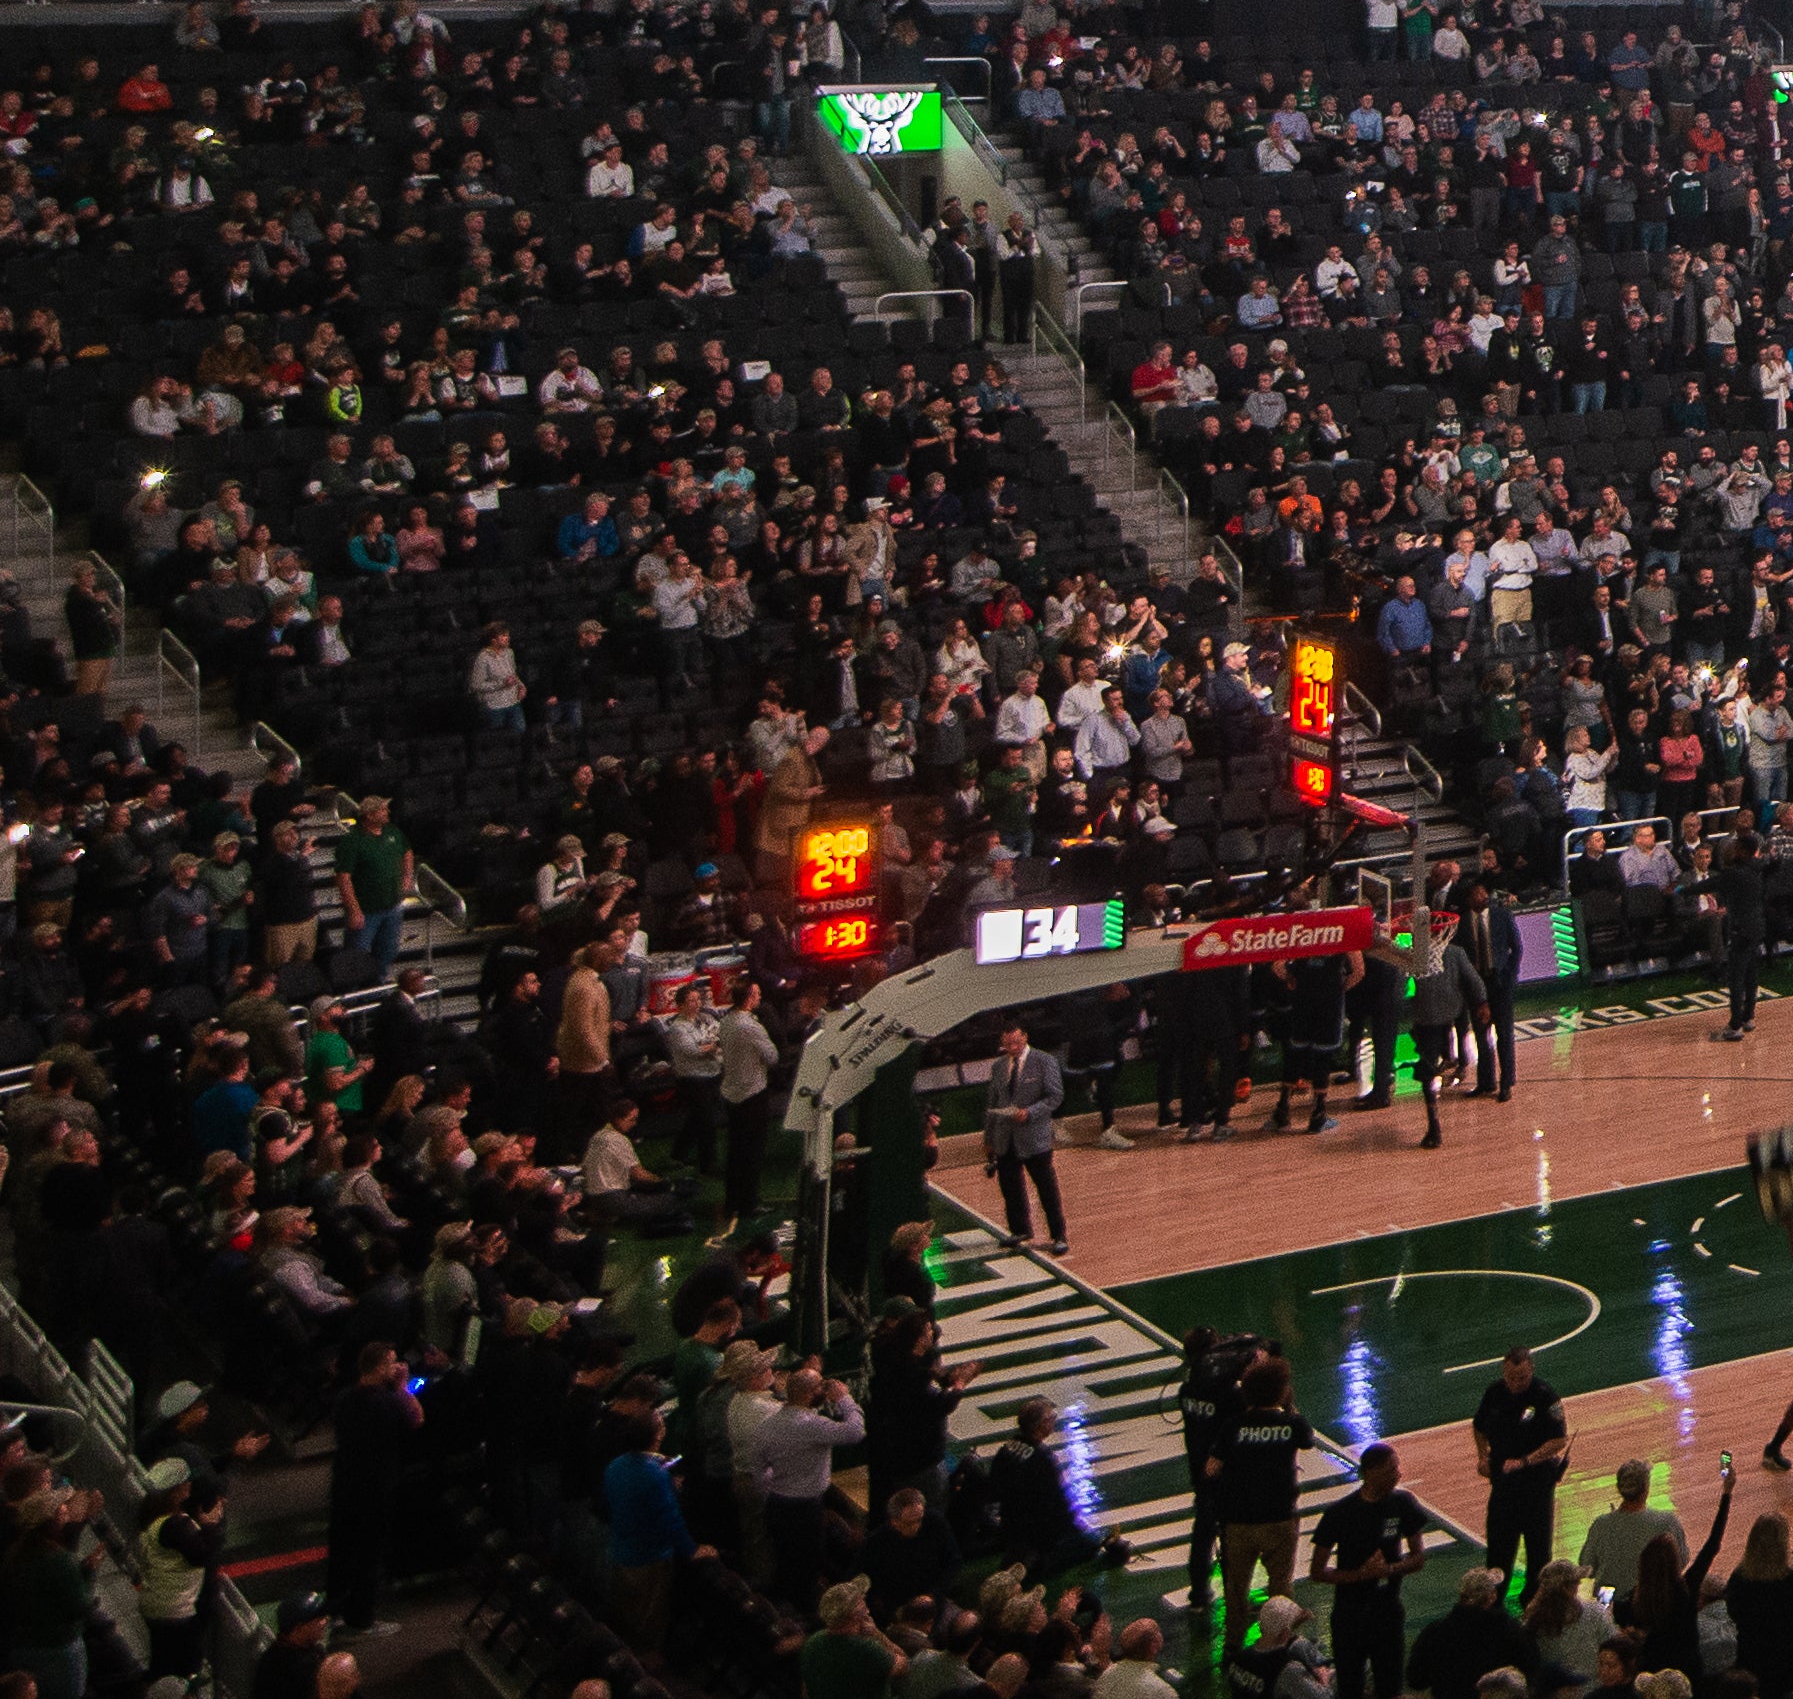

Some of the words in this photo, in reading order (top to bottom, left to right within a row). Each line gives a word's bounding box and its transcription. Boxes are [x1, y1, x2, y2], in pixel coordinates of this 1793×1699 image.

[1300, 677, 1330, 728] 24
[812, 858, 857, 891] 24
[826, 921, 867, 949] 1:30
[1021, 904, 1081, 958] 34
[1240, 1425, 1294, 1445] PHOTO
